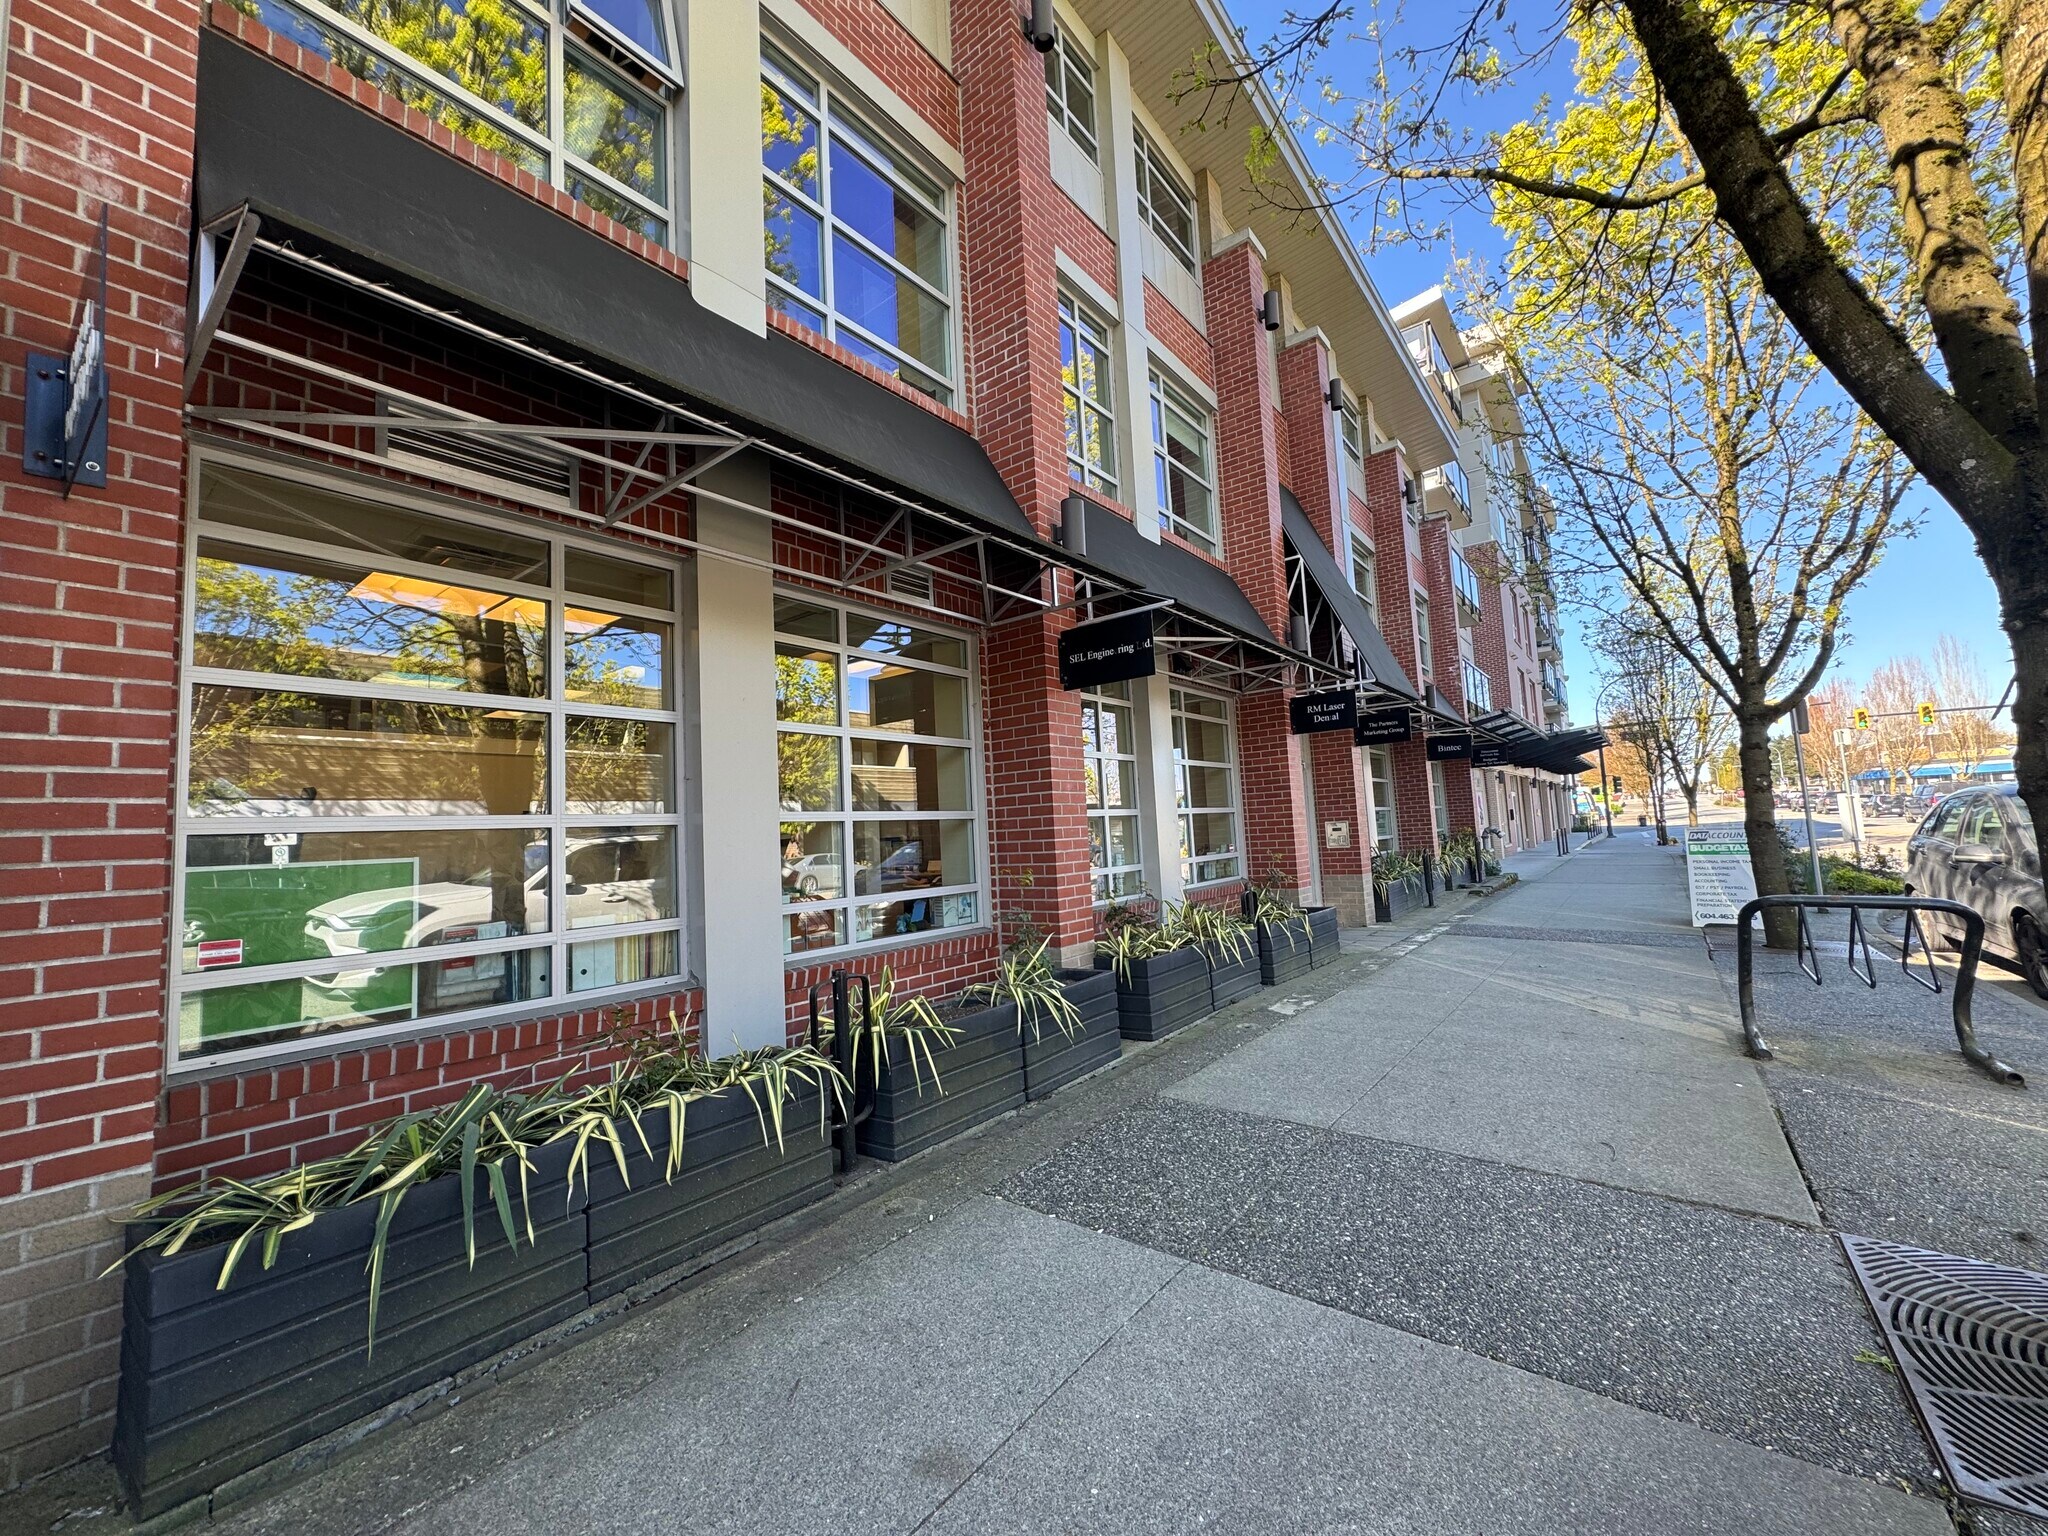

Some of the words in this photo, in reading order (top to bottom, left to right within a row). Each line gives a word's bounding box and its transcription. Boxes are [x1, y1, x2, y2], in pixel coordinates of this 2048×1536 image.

[1069, 652, 1086, 664] SEL
[1307, 704, 1321, 713] RM
[1323, 703, 1345, 712] Laser
